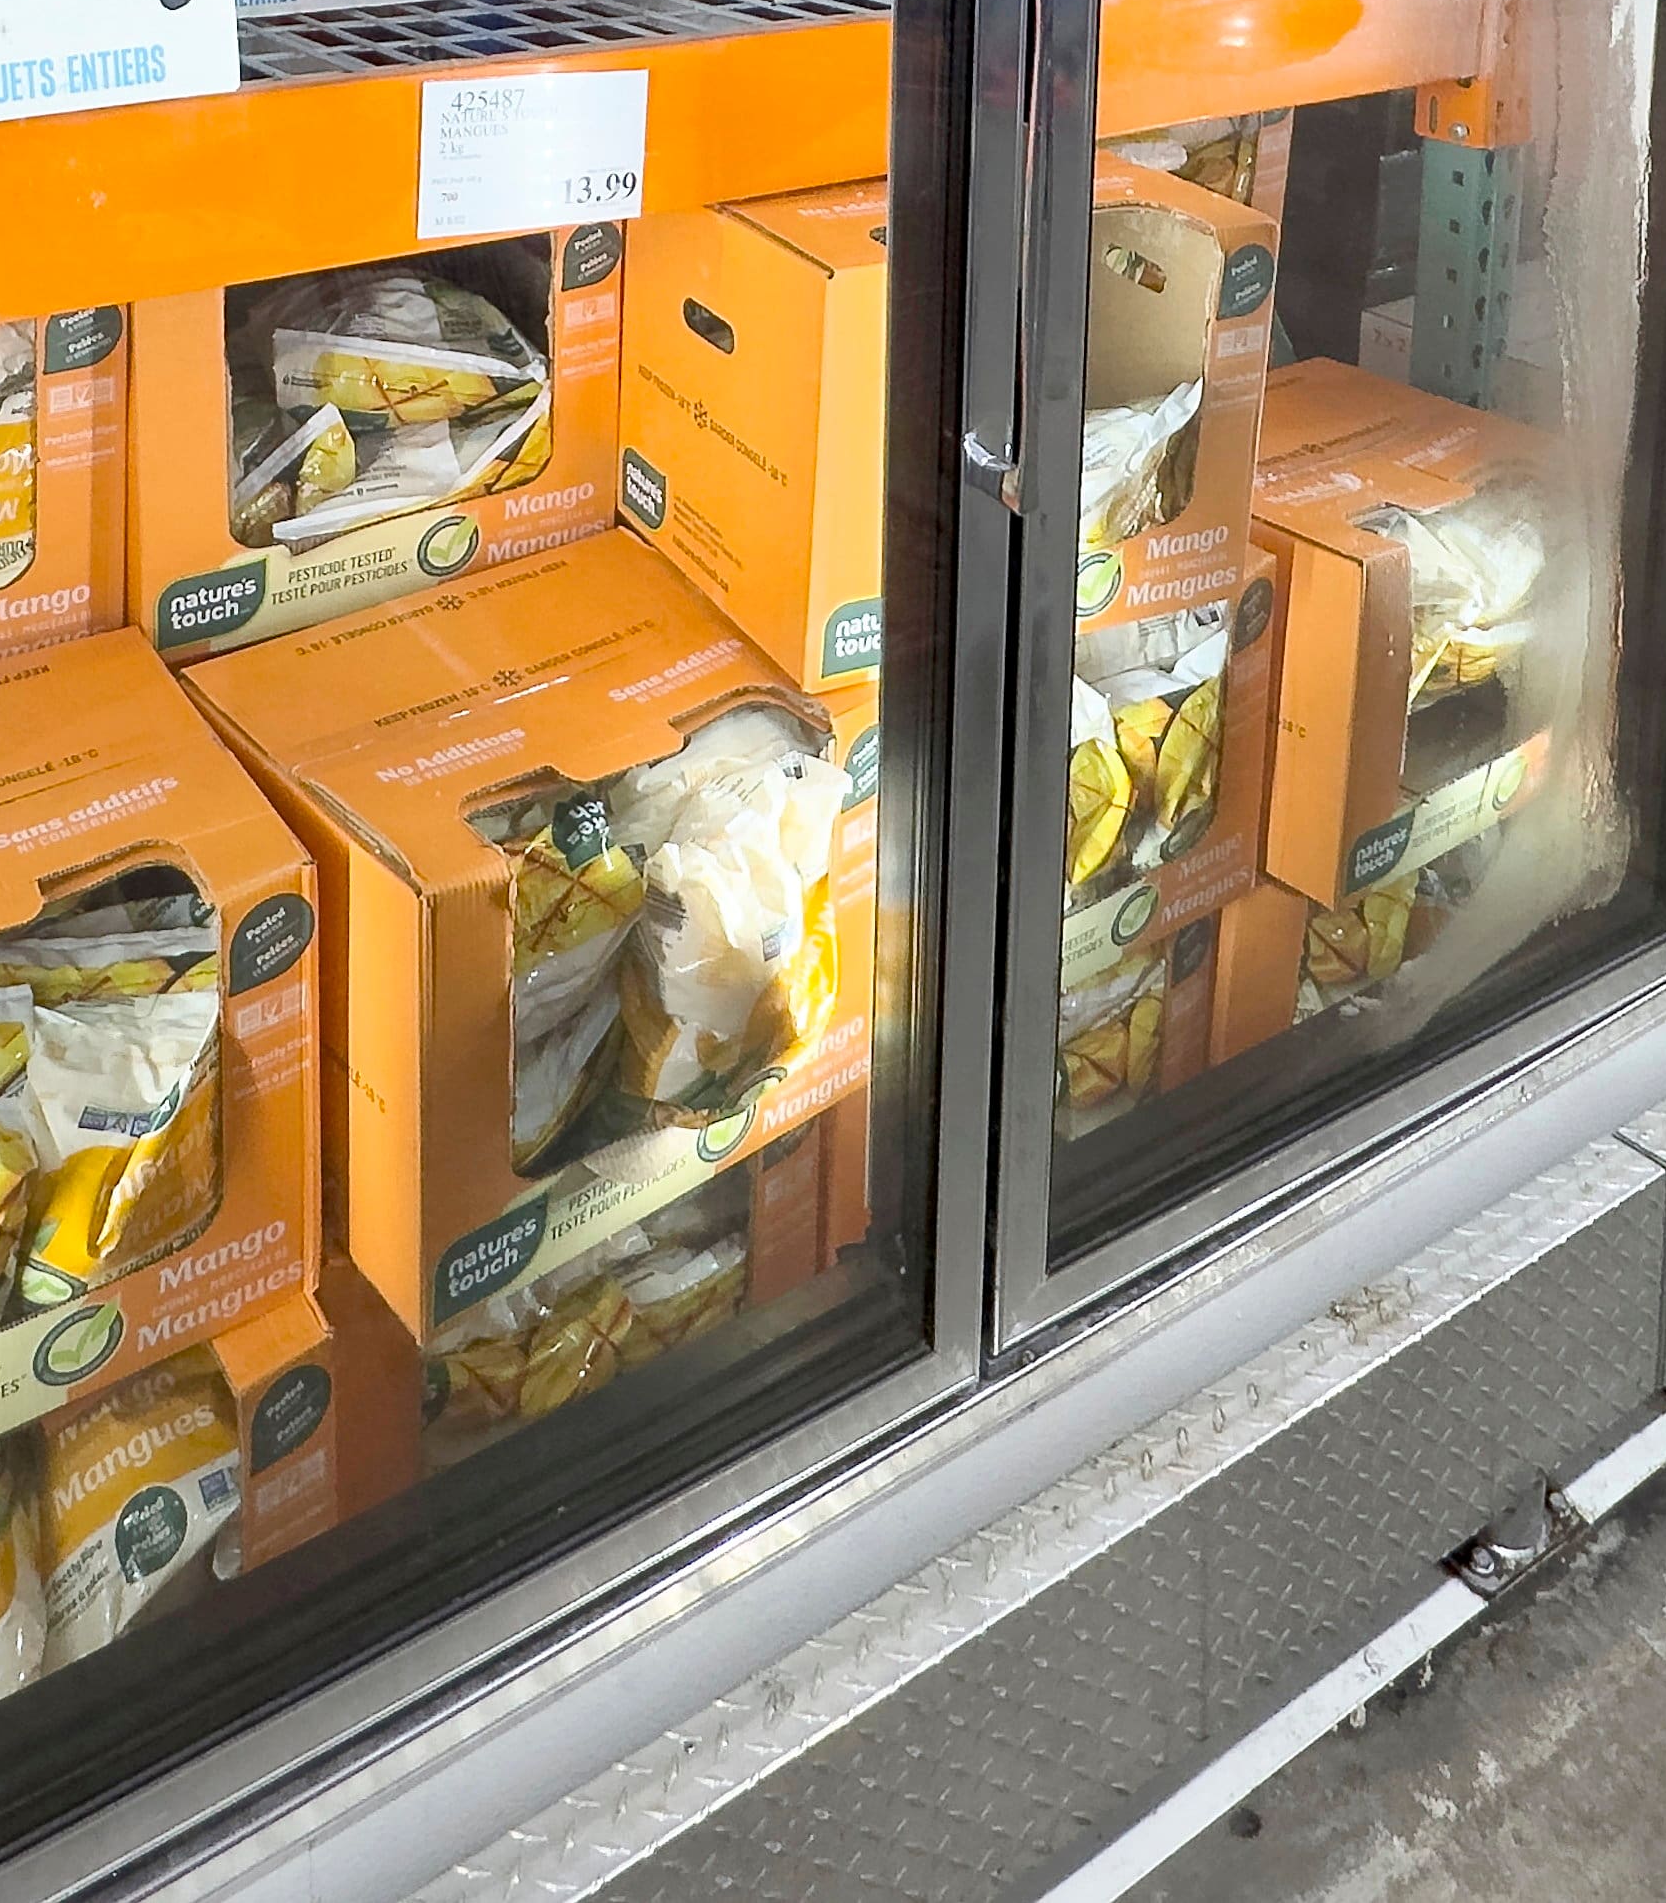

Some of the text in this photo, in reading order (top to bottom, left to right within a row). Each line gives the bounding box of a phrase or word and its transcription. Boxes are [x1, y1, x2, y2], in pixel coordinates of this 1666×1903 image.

[69, 46, 166, 98] ENTIERS
[451, 89, 525, 111] 425487
[440, 124, 508, 138] MANGUES
[563, 172, 637, 205] 13.99
[504, 483, 594, 520] Mango
[1146, 524, 1228, 561] Mango
[271, 561, 408, 605] TESTÉ POUR PESTICIDES
[288, 548, 392, 584] PESTICIDE TESTED
[1126, 565, 1237, 608] Mangues
[170, 576, 256, 614] nature's
[171, 599, 240, 631] touch
[376, 726, 524, 783] No Additives
[71, 776, 179, 826] additifs
[1178, 834, 1242, 882] Mango
[1355, 829, 1408, 862] nature's
[1355, 848, 1395, 881] touch
[1160, 866, 1250, 924] Mangues
[159, 1220, 285, 1294] Mango
[448, 1217, 538, 1275] nature's
[449, 1245, 519, 1297] touch
[137, 1260, 304, 1352] Mangues
